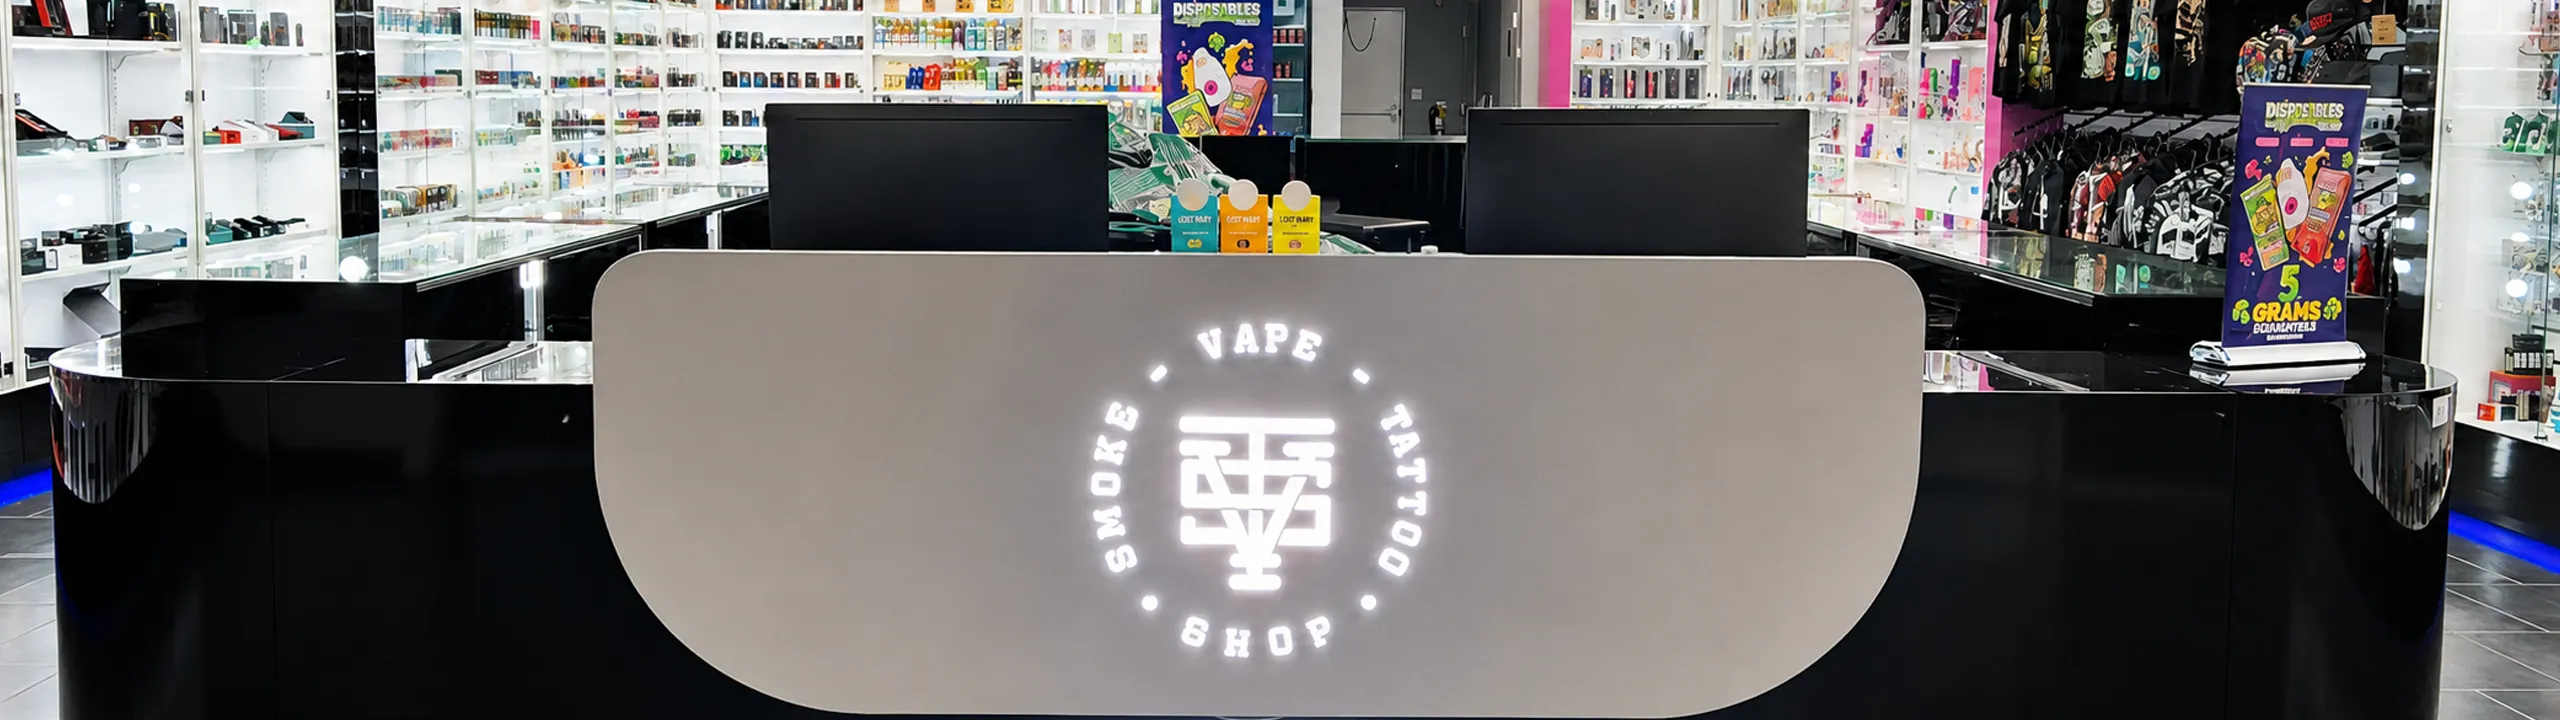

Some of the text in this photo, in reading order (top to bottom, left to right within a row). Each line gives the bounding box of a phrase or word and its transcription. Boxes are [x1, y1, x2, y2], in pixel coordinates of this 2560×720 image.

[1172, 2, 1261, 17] DISPOSABLES
[2278, 264, 2301, 303] 5
[2252, 300, 2322, 322] GRAMS
[1090, 322, 1427, 658] SMOKE VAPE TATTOO SHOP
